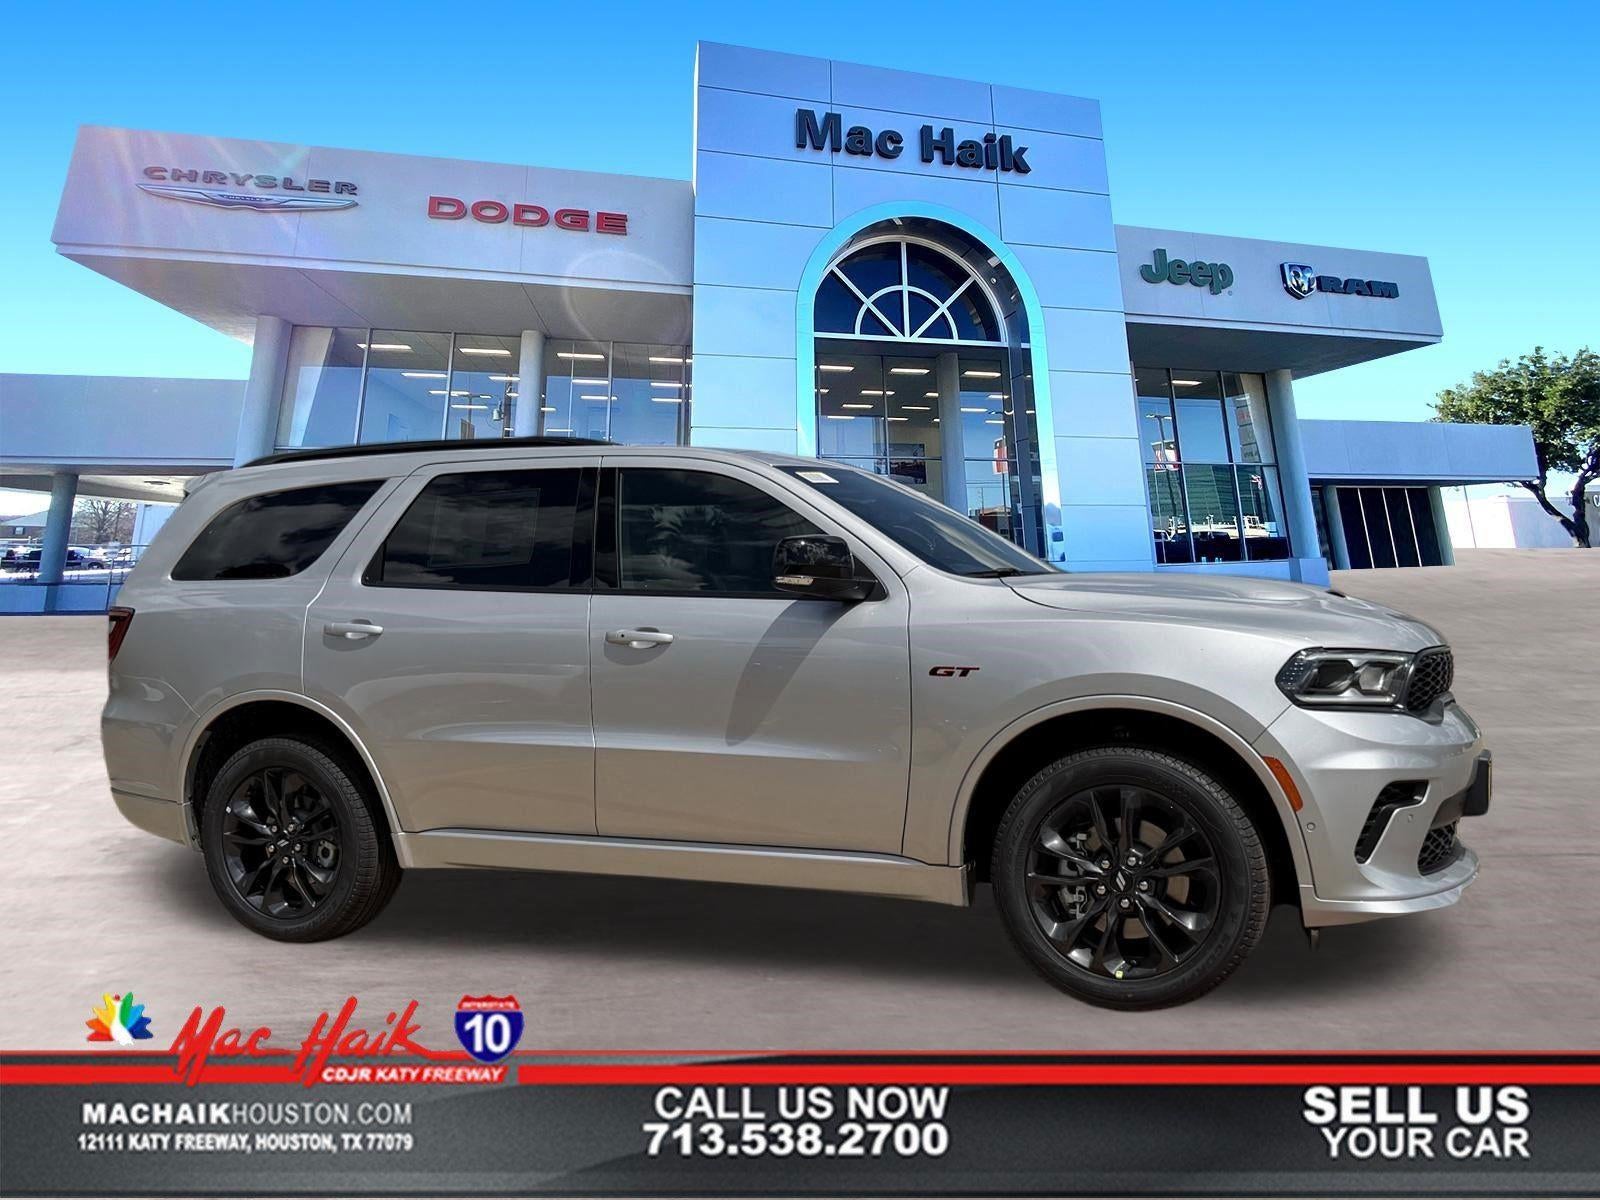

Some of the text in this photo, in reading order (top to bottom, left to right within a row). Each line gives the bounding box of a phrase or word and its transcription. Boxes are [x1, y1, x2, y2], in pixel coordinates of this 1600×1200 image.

[796, 108, 1032, 174] Mac Haik
[143, 166, 358, 196] CHRYSLER
[428, 196, 628, 236] DODGE
[1139, 248, 1234, 295] Jeep
[1315, 275, 1400, 299] RAM
[928, 666, 980, 678] GT
